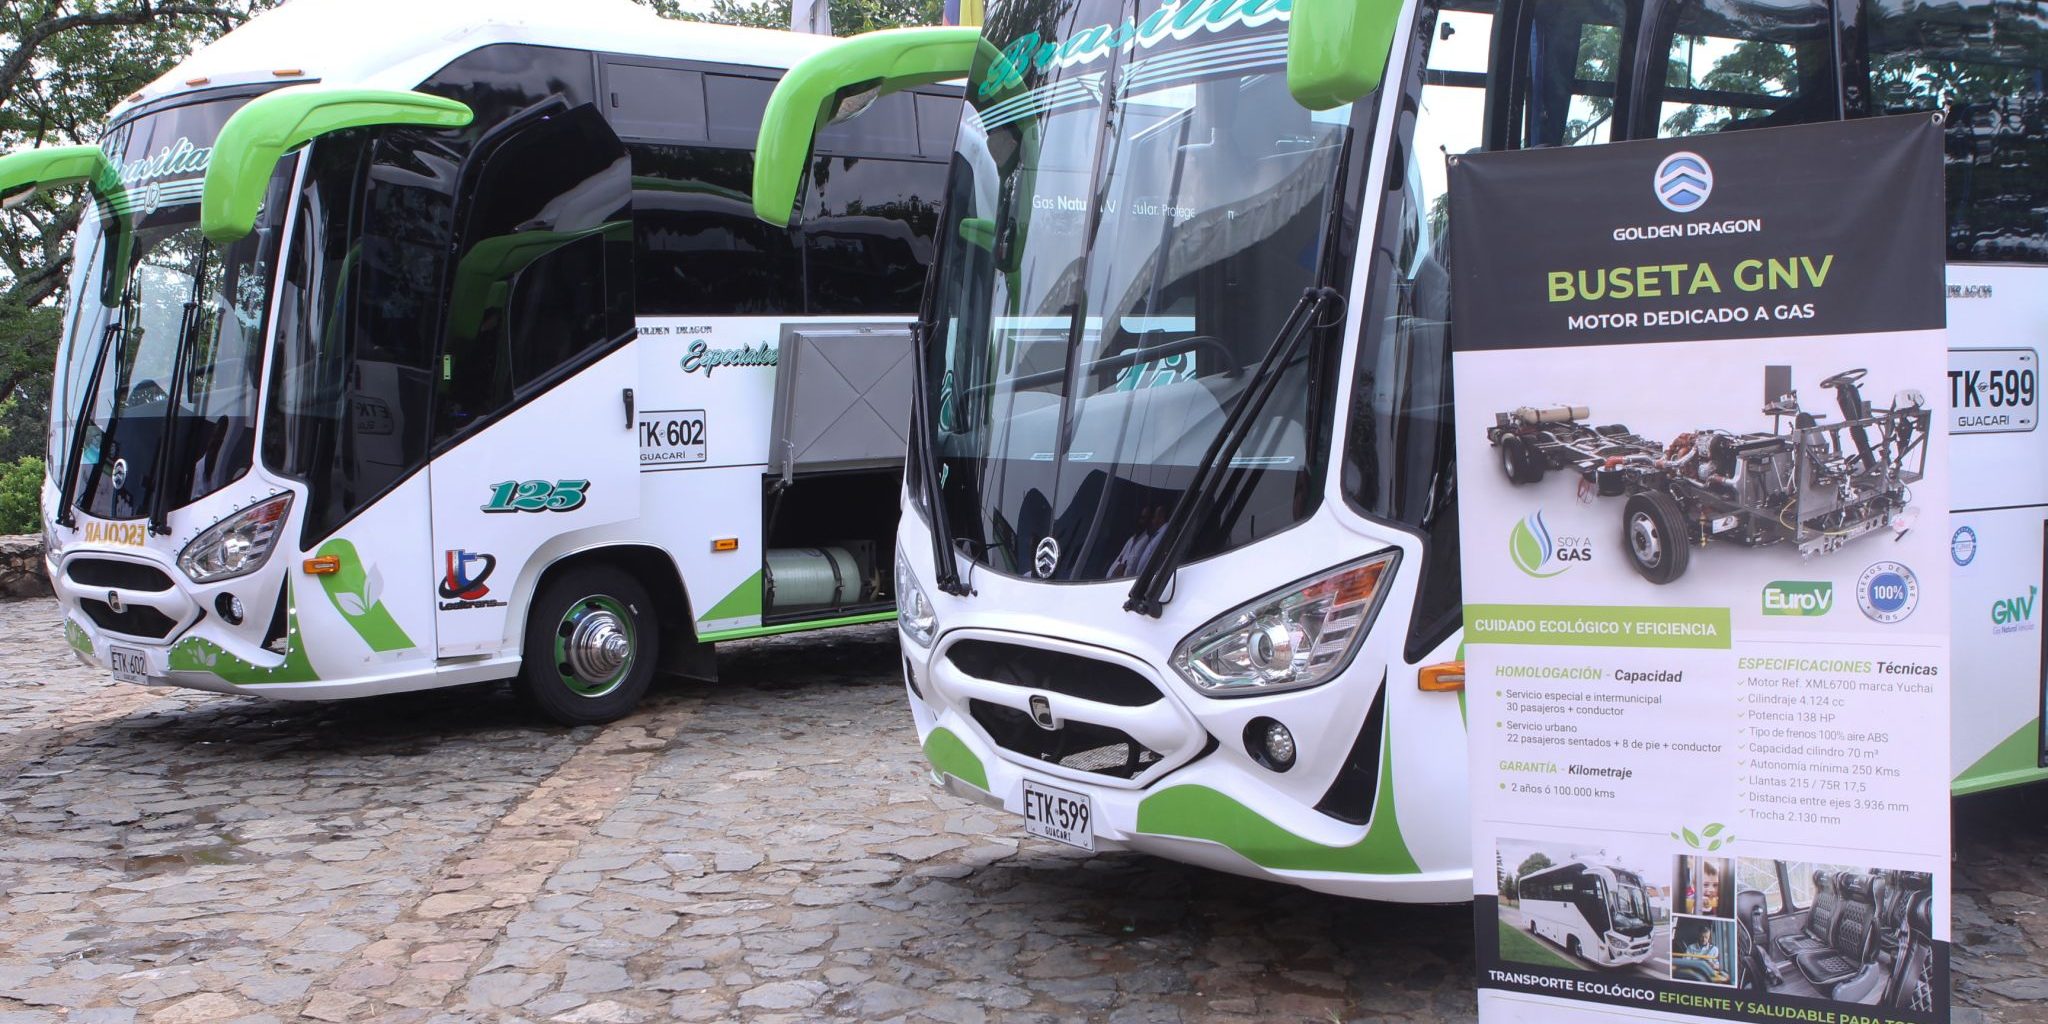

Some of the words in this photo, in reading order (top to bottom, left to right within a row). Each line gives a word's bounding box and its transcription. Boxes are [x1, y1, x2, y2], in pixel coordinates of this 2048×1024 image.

[1033, 195, 1054, 210] Gas
[1613, 224, 1683, 241] GOLDEN
[1686, 218, 1761, 237] DRAGON
[1547, 262, 1721, 302] BUSETA
[1733, 254, 1834, 293] GNV
[1568, 312, 1638, 330] MOTOR
[1643, 306, 1749, 327] DEDICADO
[1755, 307, 1769, 322] A
[1773, 303, 1815, 320] GAS
[480, 479, 591, 513] 125
[1557, 536, 1581, 548] SOY
[1583, 536, 1592, 547] A
[1556, 548, 1592, 561] GAS
[1859, 564, 1883, 600] FRENOS
[1888, 564, 1901, 573] DE
[1903, 574, 1916, 598] AIRE
[1764, 587, 1832, 610] EuroV
[1874, 585, 1904, 600] 100%
[1991, 585, 2037, 625] GNV
[1475, 619, 1536, 633] CUIDADO
[1539, 618, 1619, 634] ECOLÓGICO
[1623, 622, 1632, 634] Y
[1636, 622, 1717, 636] EFICIENCIA
[1495, 665, 1602, 680] HOMOLOGACIÓN
[1614, 669, 1683, 684] Capacidad
[1738, 658, 1872, 674] ESPECIFICACIONES
[1876, 661, 1938, 676] Técnicas
[1747, 677, 1778, 688] Motor
[1781, 678, 1801, 688] Ref.
[1805, 679, 1856, 691] XML6700
[1858, 683, 1893, 692] marca
[1897, 682, 1934, 693] Yuchai
[1506, 689, 1542, 700] Servicio
[1544, 691, 1584, 703] especial
[1585, 694, 1591, 702] e
[1593, 693, 1662, 705] intermunicipal
[1748, 693, 1797, 706] Cilindraje
[1799, 695, 1829, 706] 4.124
[1831, 698, 1845, 707] cc
[1506, 702, 1518, 711] 30
[1520, 703, 1565, 716] pasajeros
[1576, 705, 1624, 716] conductor
[1748, 709, 1794, 722] Potencia
[1797, 712, 1817, 722] 138
[1819, 713, 1836, 723] HP
[1507, 720, 1543, 731] Servicio
[1545, 722, 1577, 733] urbano
[1749, 726, 1770, 738] Tipo
[1772, 728, 1784, 738] de
[1786, 728, 1817, 739] frenos
[1819, 730, 1845, 741] 100%
[1847, 732, 1865, 742] aire
[1867, 732, 1889, 743] ABS
[1507, 734, 1518, 743] 22
[1520, 734, 1565, 747] pasajeros
[1567, 737, 1611, 748] sentados
[1622, 739, 1629, 749] 8
[1631, 740, 1643, 749] de
[1645, 741, 1661, 752] pie
[1671, 742, 1722, 753] conductor
[1749, 743, 1804, 755] Capacidad
[1806, 745, 1845, 757] cilindro
[1848, 747, 1861, 758] 70
[1499, 760, 1558, 774] GARANTÍA
[1568, 764, 1633, 780] Kilometraje
[1750, 759, 1807, 771] Autonomía
[1809, 762, 1849, 774] mínima
[1852, 765, 1872, 775] 250
[1875, 766, 1900, 777] Kms
[1511, 783, 1518, 792] 2
[1520, 783, 1543, 794] años
[1544, 784, 1551, 794] ó
[1553, 786, 1592, 798] 100.000
[1594, 788, 1615, 799] kms
[1749, 776, 1787, 787] Llantas
[1789, 778, 1809, 788] 215
[1811, 779, 1817, 789] /
[1819, 780, 1841, 790] 75R
[1844, 781, 1866, 793] 17,5
[1749, 792, 1797, 805] Distancia
[1800, 796, 1827, 807] entre
[1829, 798, 1851, 809] ejes
[1854, 799, 1885, 811] 3.936
[1887, 803, 1909, 812] mm
[1750, 808, 1785, 821] Trocha
[1787, 812, 1817, 823] 2.130
[1819, 815, 1841, 825] mm
[1488, 970, 1574, 991] TRANSPORTE
[1576, 981, 1655, 1001] ECOLÓGICO
[1659, 991, 1731, 1011] EFICIENTE
[1734, 1001, 1744, 1012] Y
[1747, 1003, 1836, 1024] SALUDABLE
